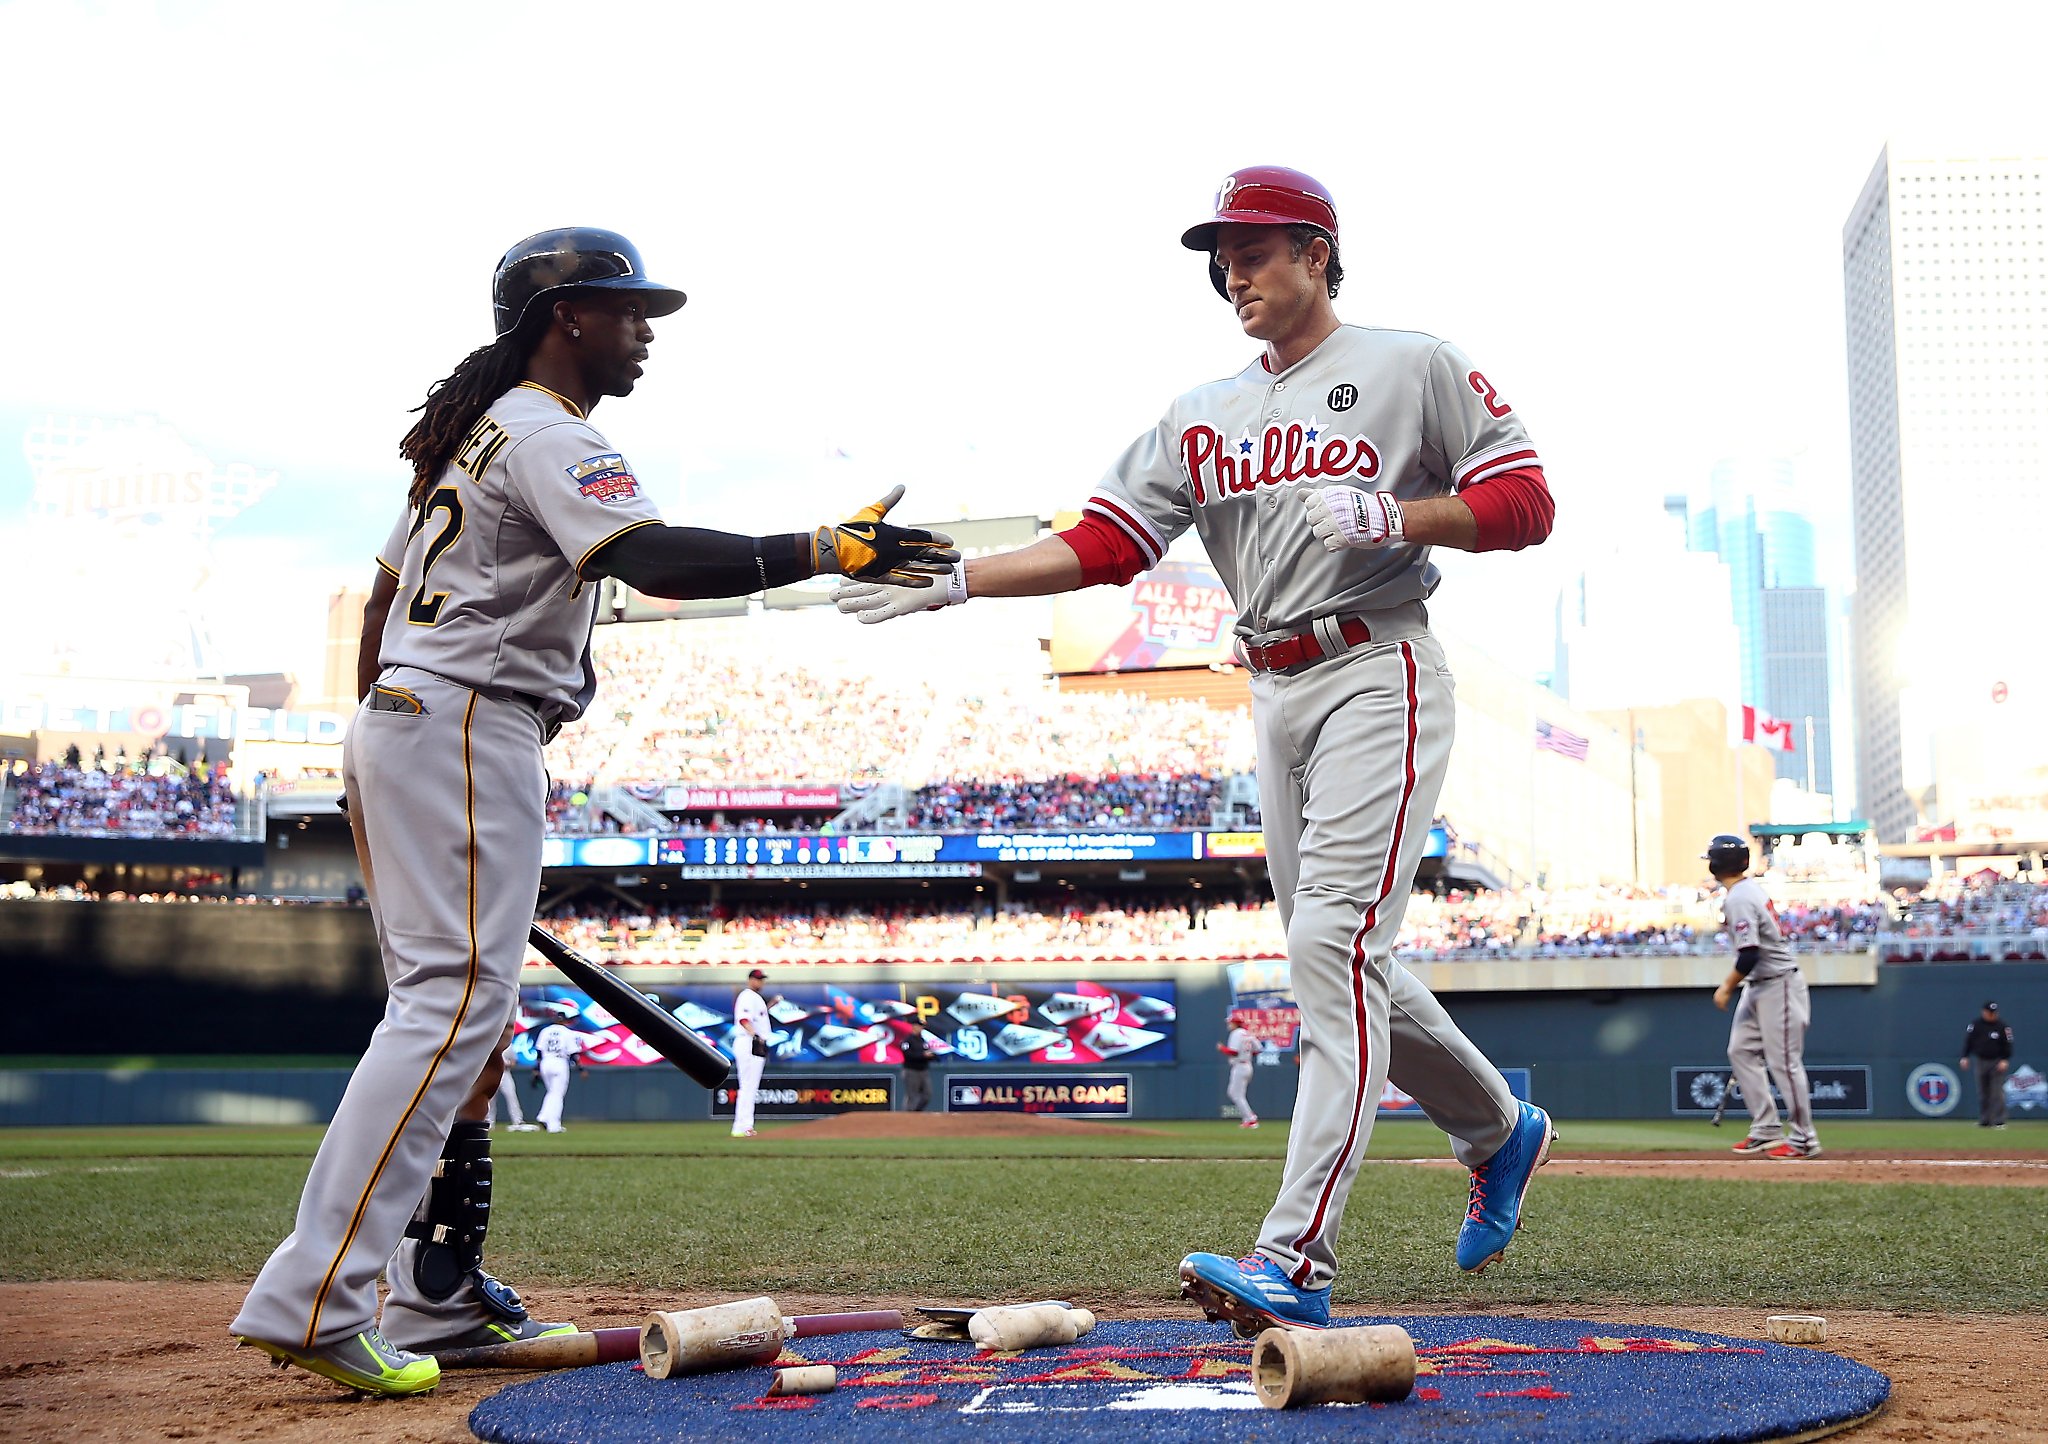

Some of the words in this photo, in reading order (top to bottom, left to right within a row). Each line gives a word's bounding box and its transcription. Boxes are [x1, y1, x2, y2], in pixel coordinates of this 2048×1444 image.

[1331, 386, 1353, 409] CB
[1180, 418, 1384, 508] Phillies
[598, 484, 630, 496] GAME
[1154, 606, 1216, 628] GAME
[181, 704, 348, 745] FIELD
[982, 1086, 1018, 1104] ALL
[1022, 1085, 1071, 1104] STAR
[1072, 1085, 1127, 1104] GAME
